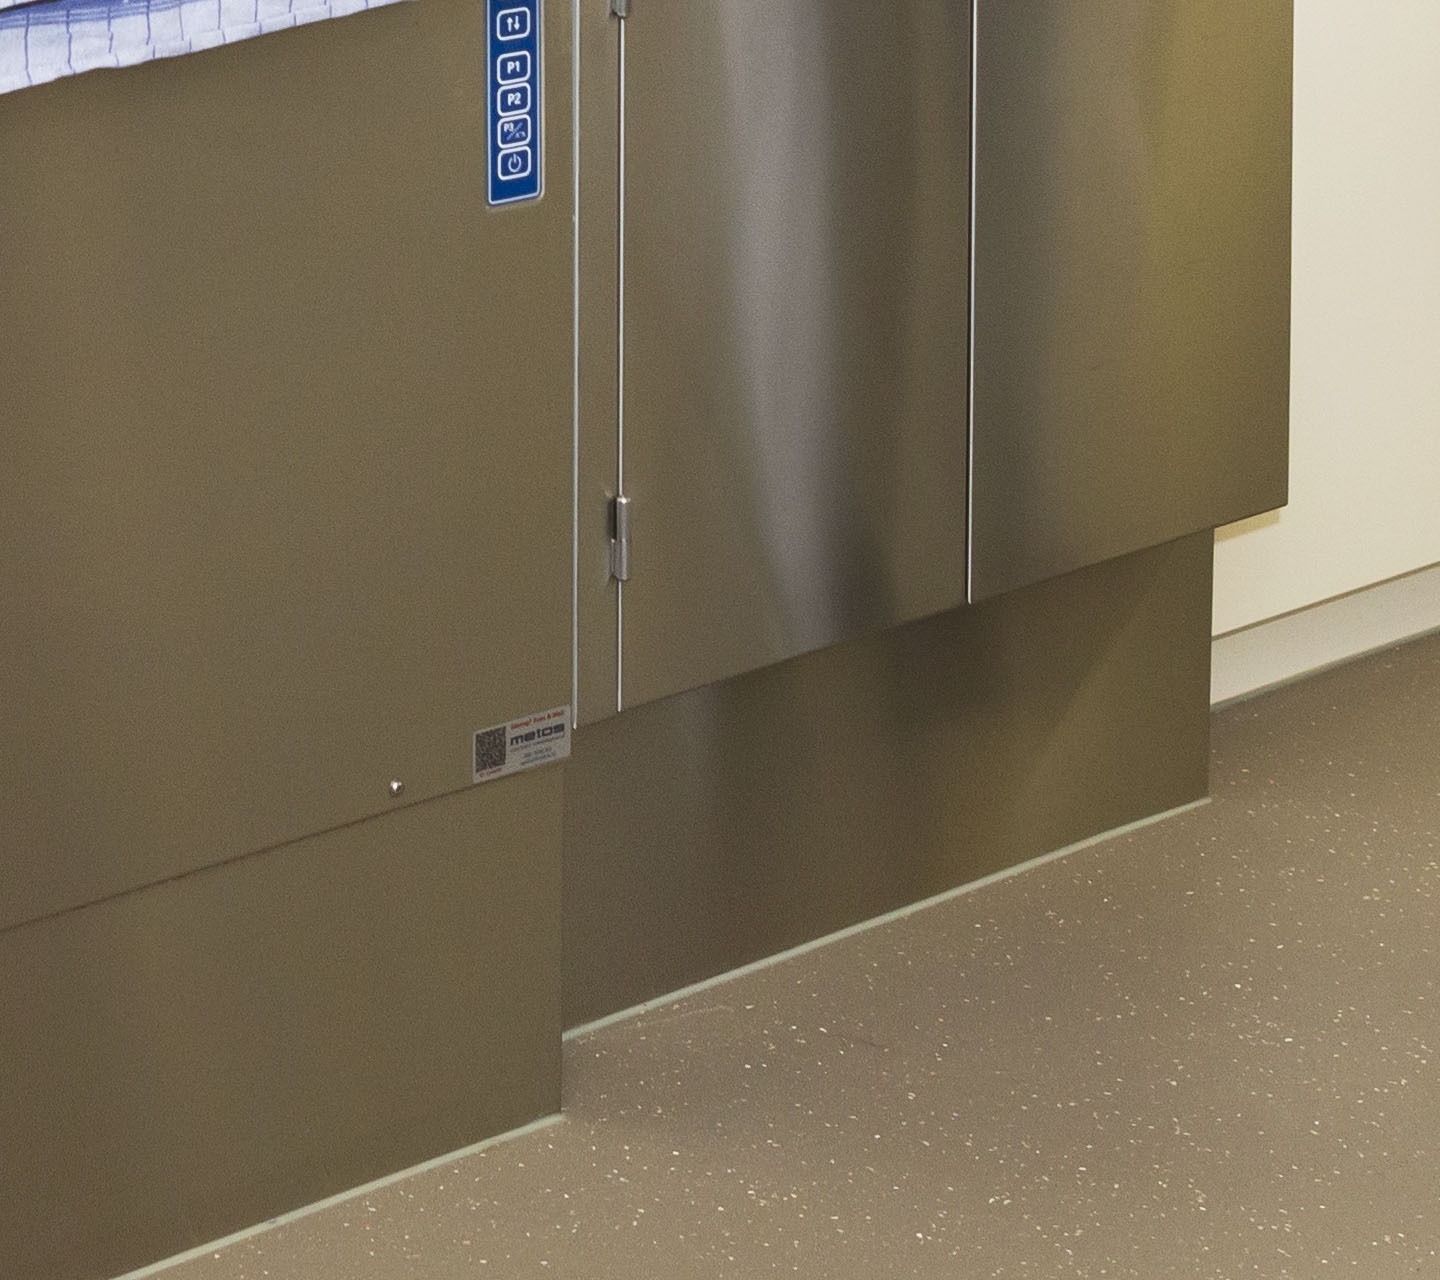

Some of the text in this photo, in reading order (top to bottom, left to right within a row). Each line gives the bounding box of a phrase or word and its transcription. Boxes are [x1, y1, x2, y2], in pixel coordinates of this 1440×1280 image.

[507, 61, 520, 75] P1
[507, 91, 522, 106] P2
[510, 723, 565, 746] metos
